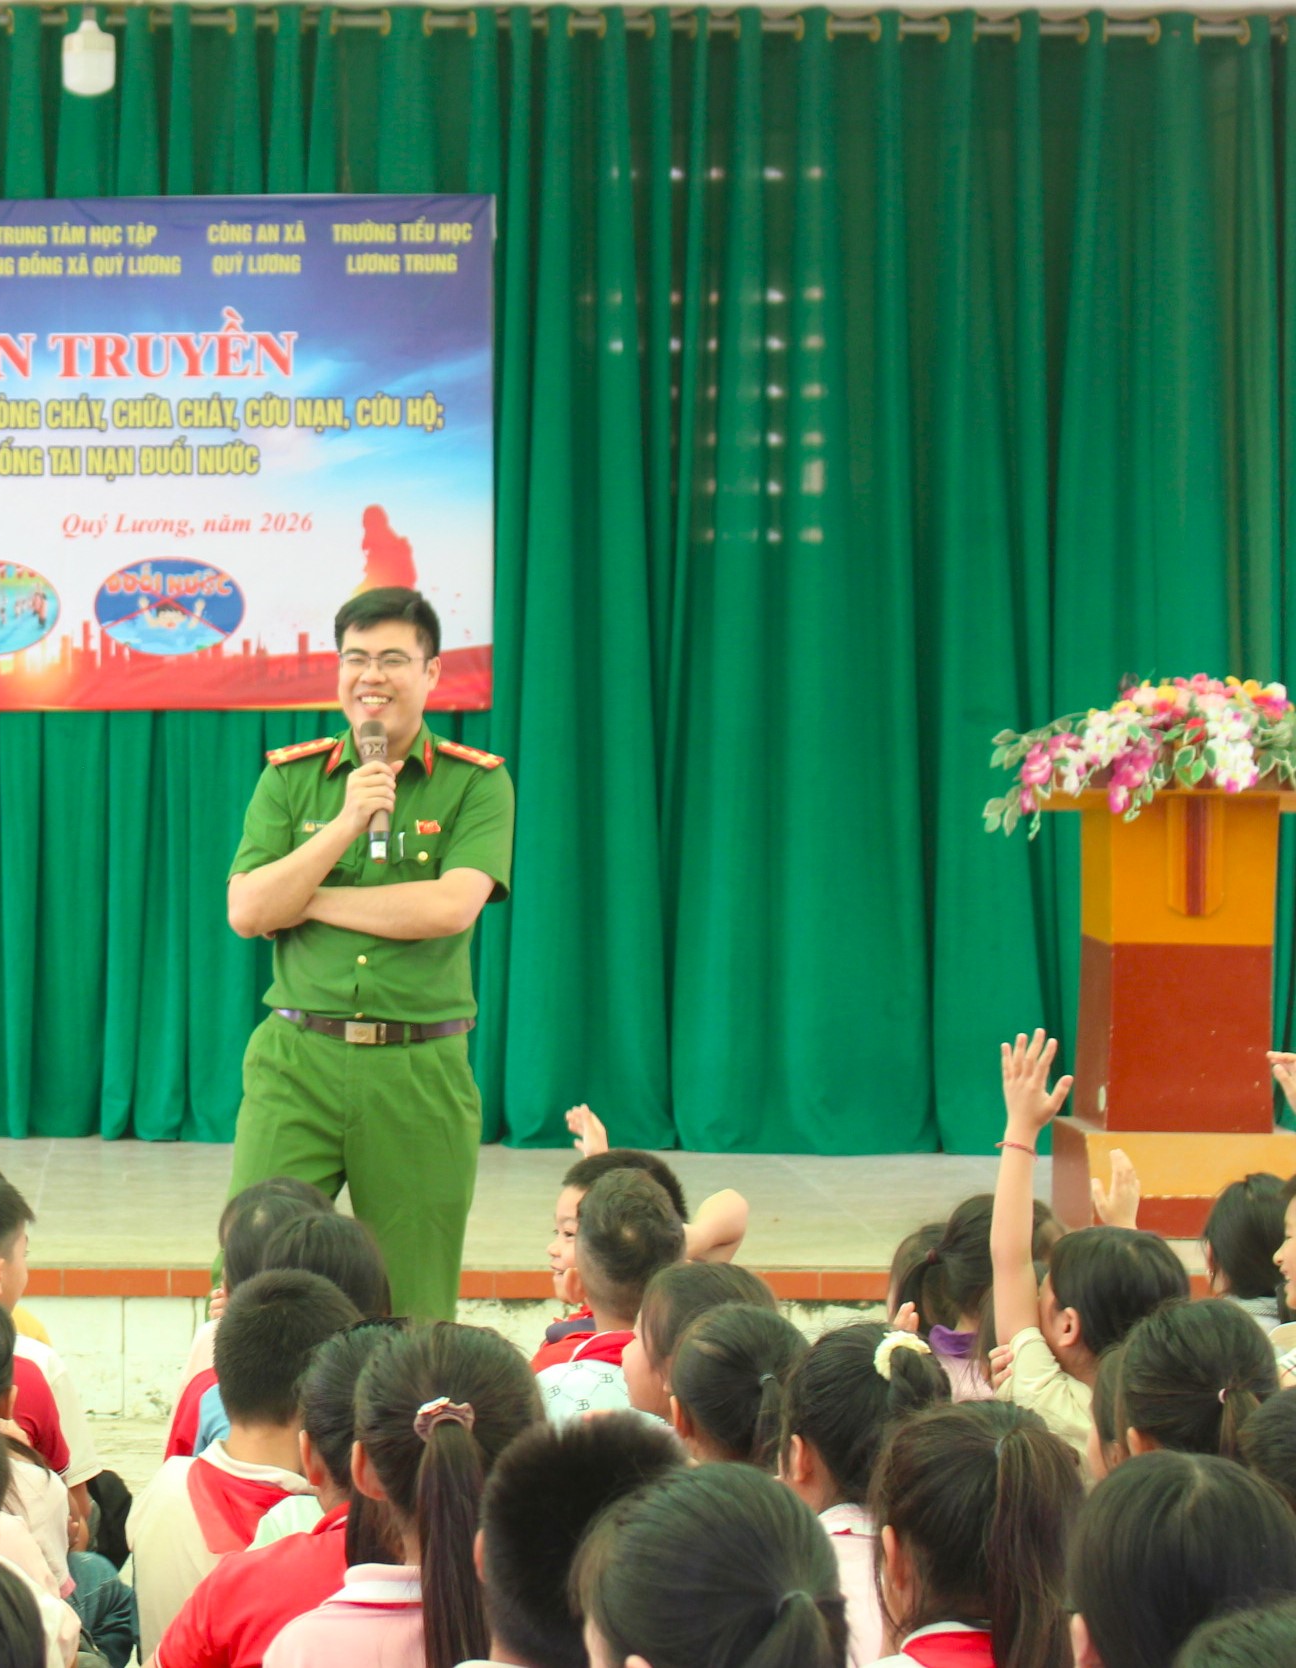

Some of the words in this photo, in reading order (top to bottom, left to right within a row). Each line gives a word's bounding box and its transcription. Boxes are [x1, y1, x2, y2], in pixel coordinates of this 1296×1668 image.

[51, 222, 86, 245] TÂM
[89, 224, 123, 248] HỌC
[126, 222, 158, 248] TẬP
[207, 220, 253, 244] CÔNG
[256, 223, 280, 243] AN
[284, 220, 307, 243] XÃ
[332, 219, 397, 243] TRƯỜNG
[400, 216, 436, 242] TIỂU
[438, 222, 473, 248] HỌC
[66, 252, 90, 276] XÃ
[127, 254, 182, 276] LƯƠNG
[246, 253, 302, 275] LƯƠNG
[346, 252, 401, 275] LƯƠNG
[404, 253, 459, 274] TRUNG
[48, 306, 298, 380] TRUYỀN
[44, 393, 108, 433] CHÁY,
[111, 394, 173, 429] CHỮA
[176, 393, 240, 432] CHÁY,
[244, 394, 291, 429] CỨU
[294, 397, 350, 434] NẠN,
[355, 393, 401, 428] CỨU
[405, 391, 445, 433] HỘ;
[48, 446, 82, 476] TAI
[86, 446, 135, 482] NẠN
[138, 436, 193, 476] ĐUỐI
[197, 440, 261, 475] NƯỚC
[62, 512, 109, 539] Quý
[115, 513, 195, 539] Lương,
[203, 514, 252, 533] năm
[259, 511, 313, 533] 2026
